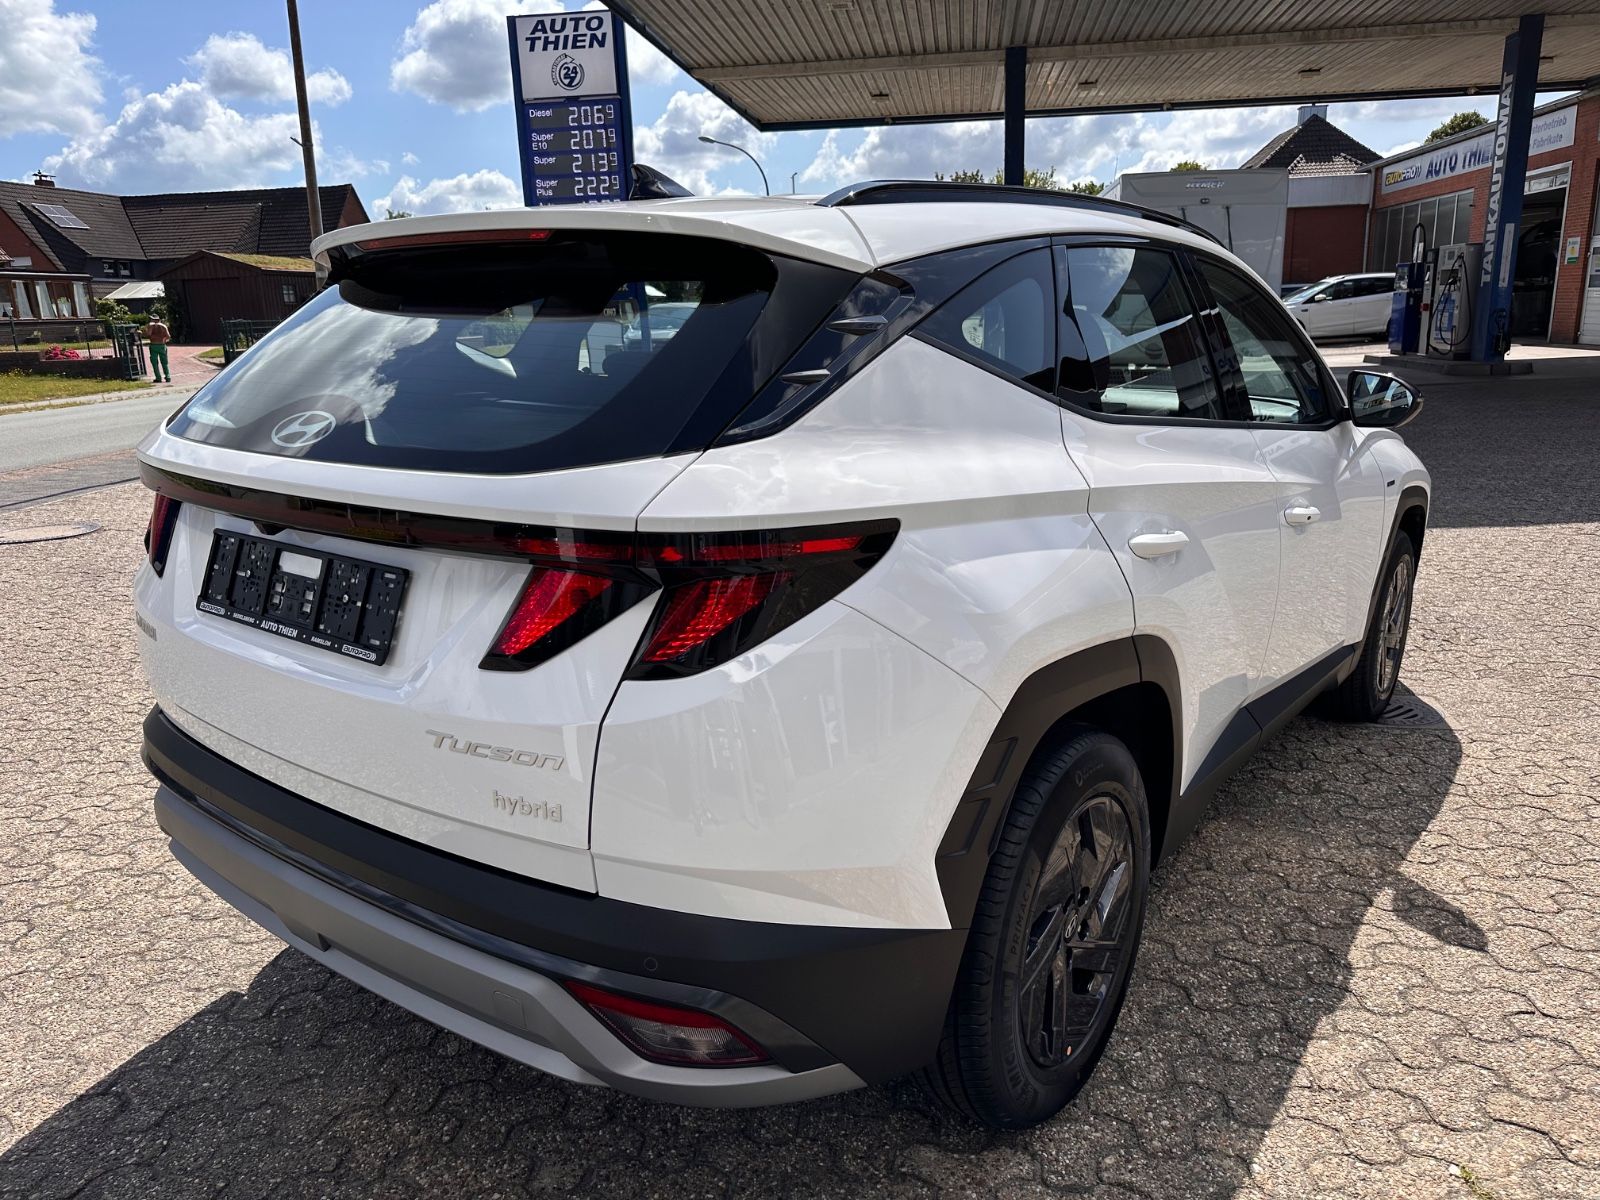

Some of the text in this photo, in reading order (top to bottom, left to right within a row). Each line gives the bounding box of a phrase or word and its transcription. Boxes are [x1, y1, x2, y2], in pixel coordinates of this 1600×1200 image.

[530, 15, 604, 35] AUTO
[525, 32, 607, 52] THIEN
[529, 104, 614, 126] Diesel 2069
[531, 133, 554, 142] Super
[532, 128, 616, 150] E10 2079
[533, 152, 618, 173] Super 2139
[1425, 151, 1458, 179] AUTO
[1462, 142, 1493, 169] THIE
[536, 179, 558, 188] Super
[536, 175, 620, 196] Plus 2229
[1480, 72, 1514, 288] TANKAUTOMAT
[260, 620, 278, 632] AUTO
[278, 624, 298, 638] THIEN
[492, 789, 563, 823] hybrid
